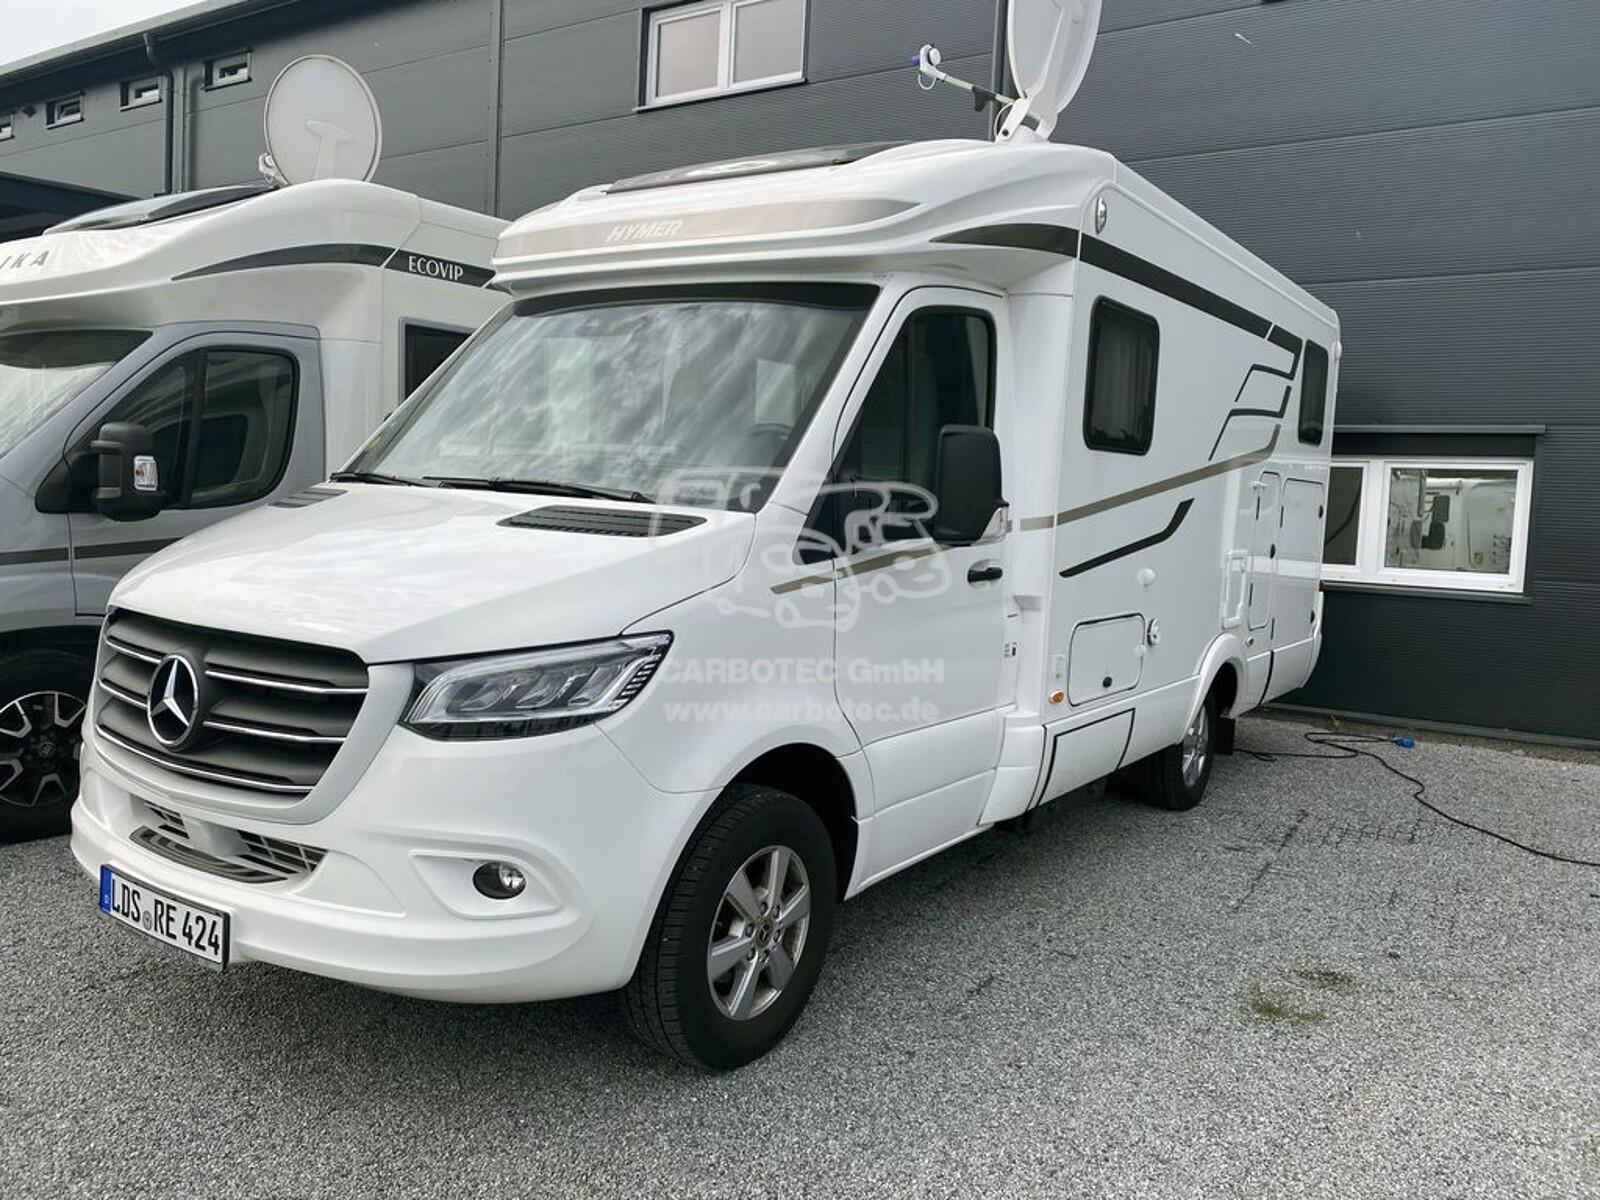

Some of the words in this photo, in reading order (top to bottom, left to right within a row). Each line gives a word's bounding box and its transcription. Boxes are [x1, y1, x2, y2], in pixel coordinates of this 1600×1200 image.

[606, 220, 683, 242] HYMER
[408, 255, 464, 281] ECOVIP
[112, 878, 142, 923] LDS
[154, 898, 178, 940] RE
[182, 911, 220, 956] 424
